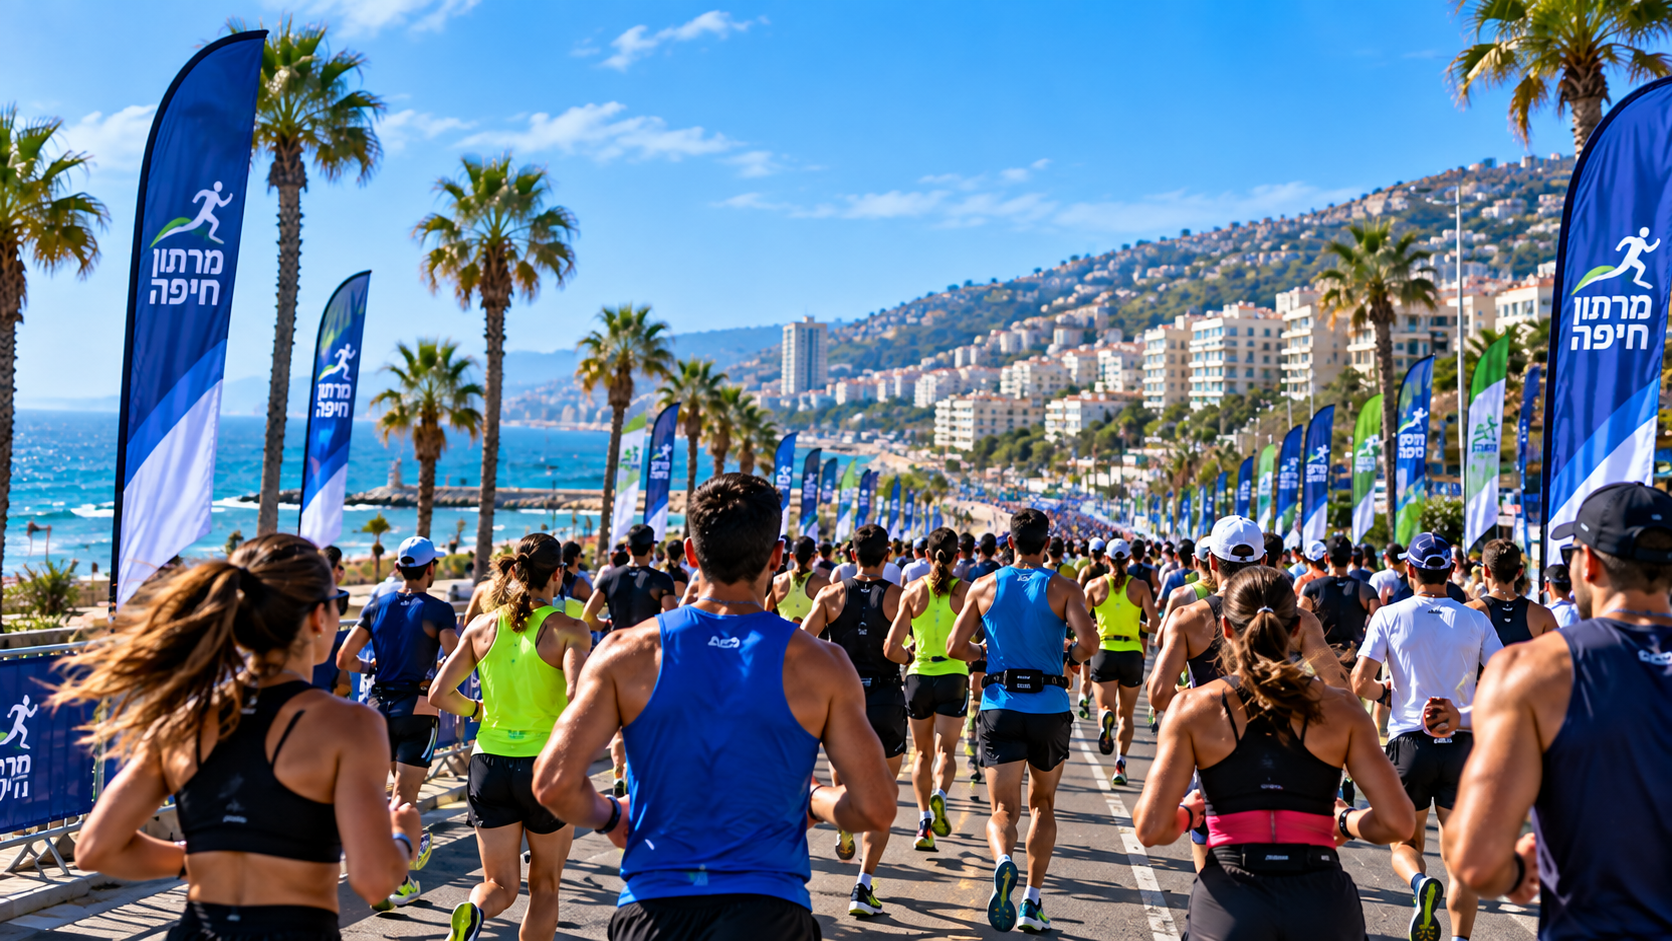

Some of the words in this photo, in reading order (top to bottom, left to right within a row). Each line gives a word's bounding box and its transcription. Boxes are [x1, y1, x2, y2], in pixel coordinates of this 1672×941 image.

[152, 248, 224, 278] מרתון
[149, 278, 220, 306] חיפה
[1573, 295, 1652, 325] מרתון
[1570, 324, 1649, 351] חיפה
[317, 383, 351, 401] מרתון
[315, 401, 349, 418] חיפה
